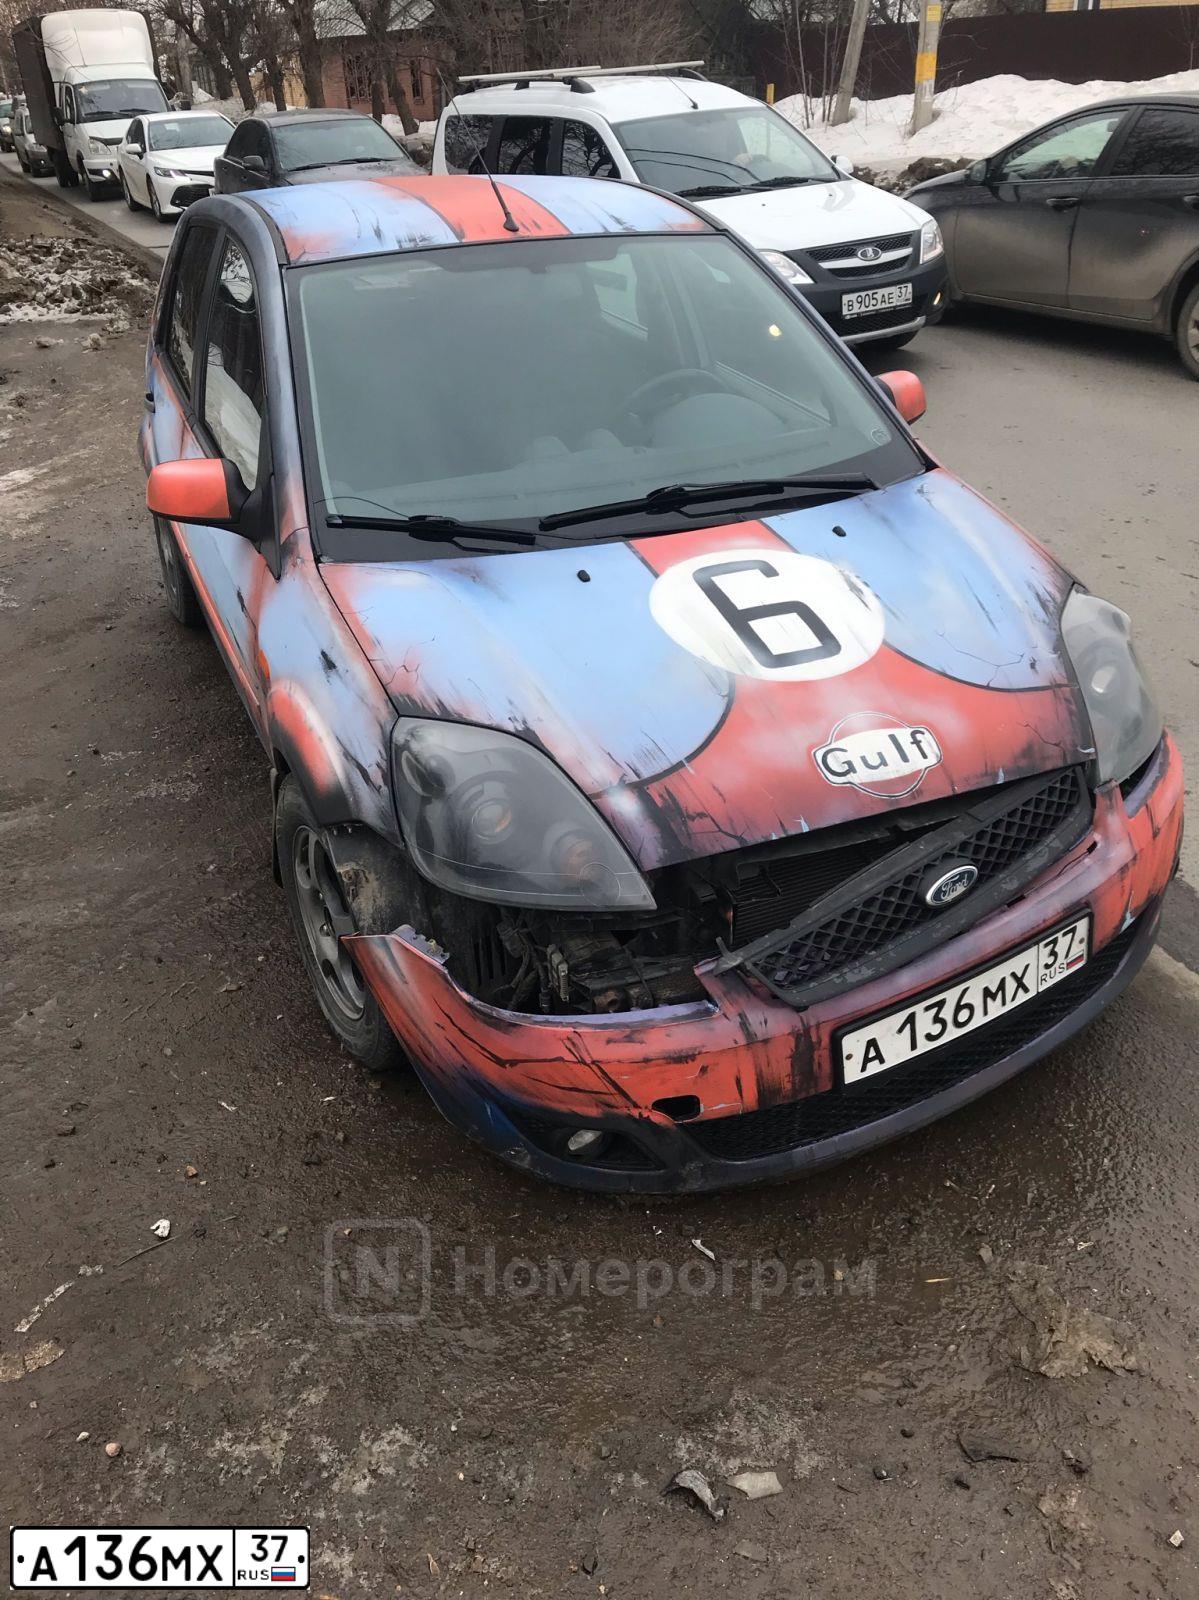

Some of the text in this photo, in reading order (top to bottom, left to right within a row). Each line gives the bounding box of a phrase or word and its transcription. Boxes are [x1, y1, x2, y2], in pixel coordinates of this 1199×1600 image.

[897, 285, 908, 298] 37
[692, 559, 842, 669] 6
[821, 729, 928, 777] Gulf
[941, 874, 969, 900] Ford
[1043, 925, 1077, 970] 37
[1040, 963, 1065, 985] RUS
